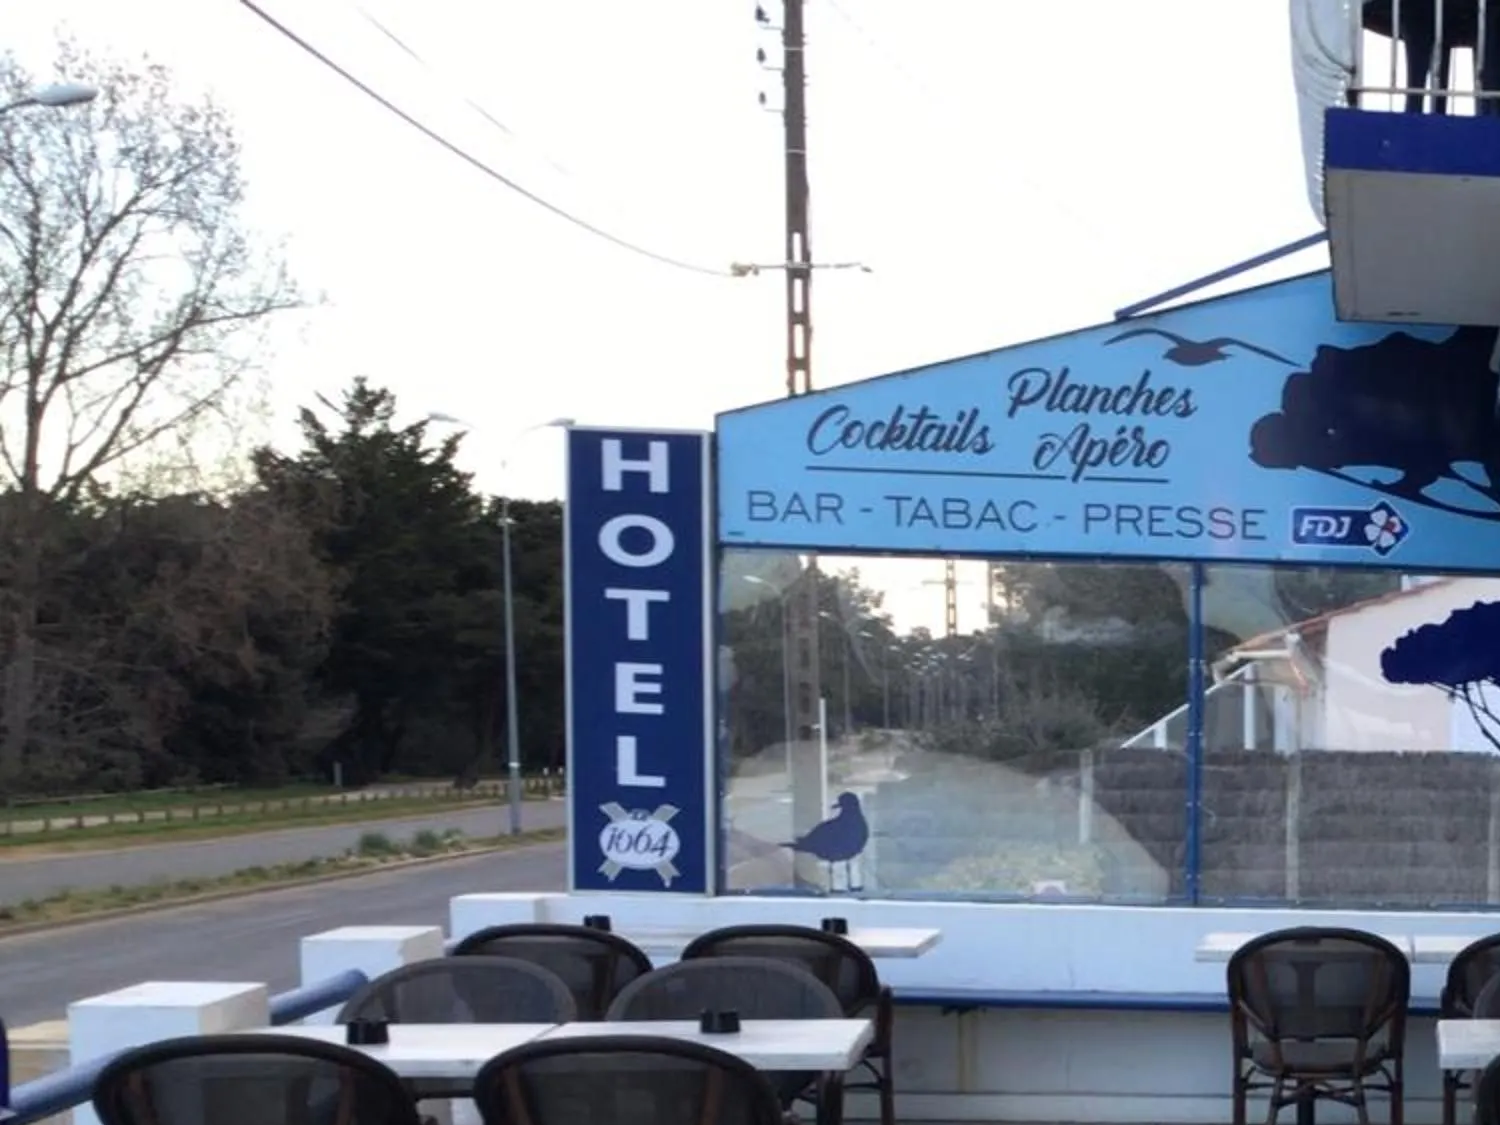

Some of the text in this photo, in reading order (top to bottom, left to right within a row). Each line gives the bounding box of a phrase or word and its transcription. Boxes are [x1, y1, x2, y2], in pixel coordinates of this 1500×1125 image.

[1007, 367, 1197, 418] Planches
[806, 404, 994, 455] Cocktails
[1033, 422, 1170, 483] Apéro
[747, 490, 844, 525] BAR
[883, 495, 1038, 532] TABAC
[1083, 503, 1268, 541] PRESSE
[1299, 514, 1353, 539] FDJ
[598, 438, 675, 788] HOTEL
